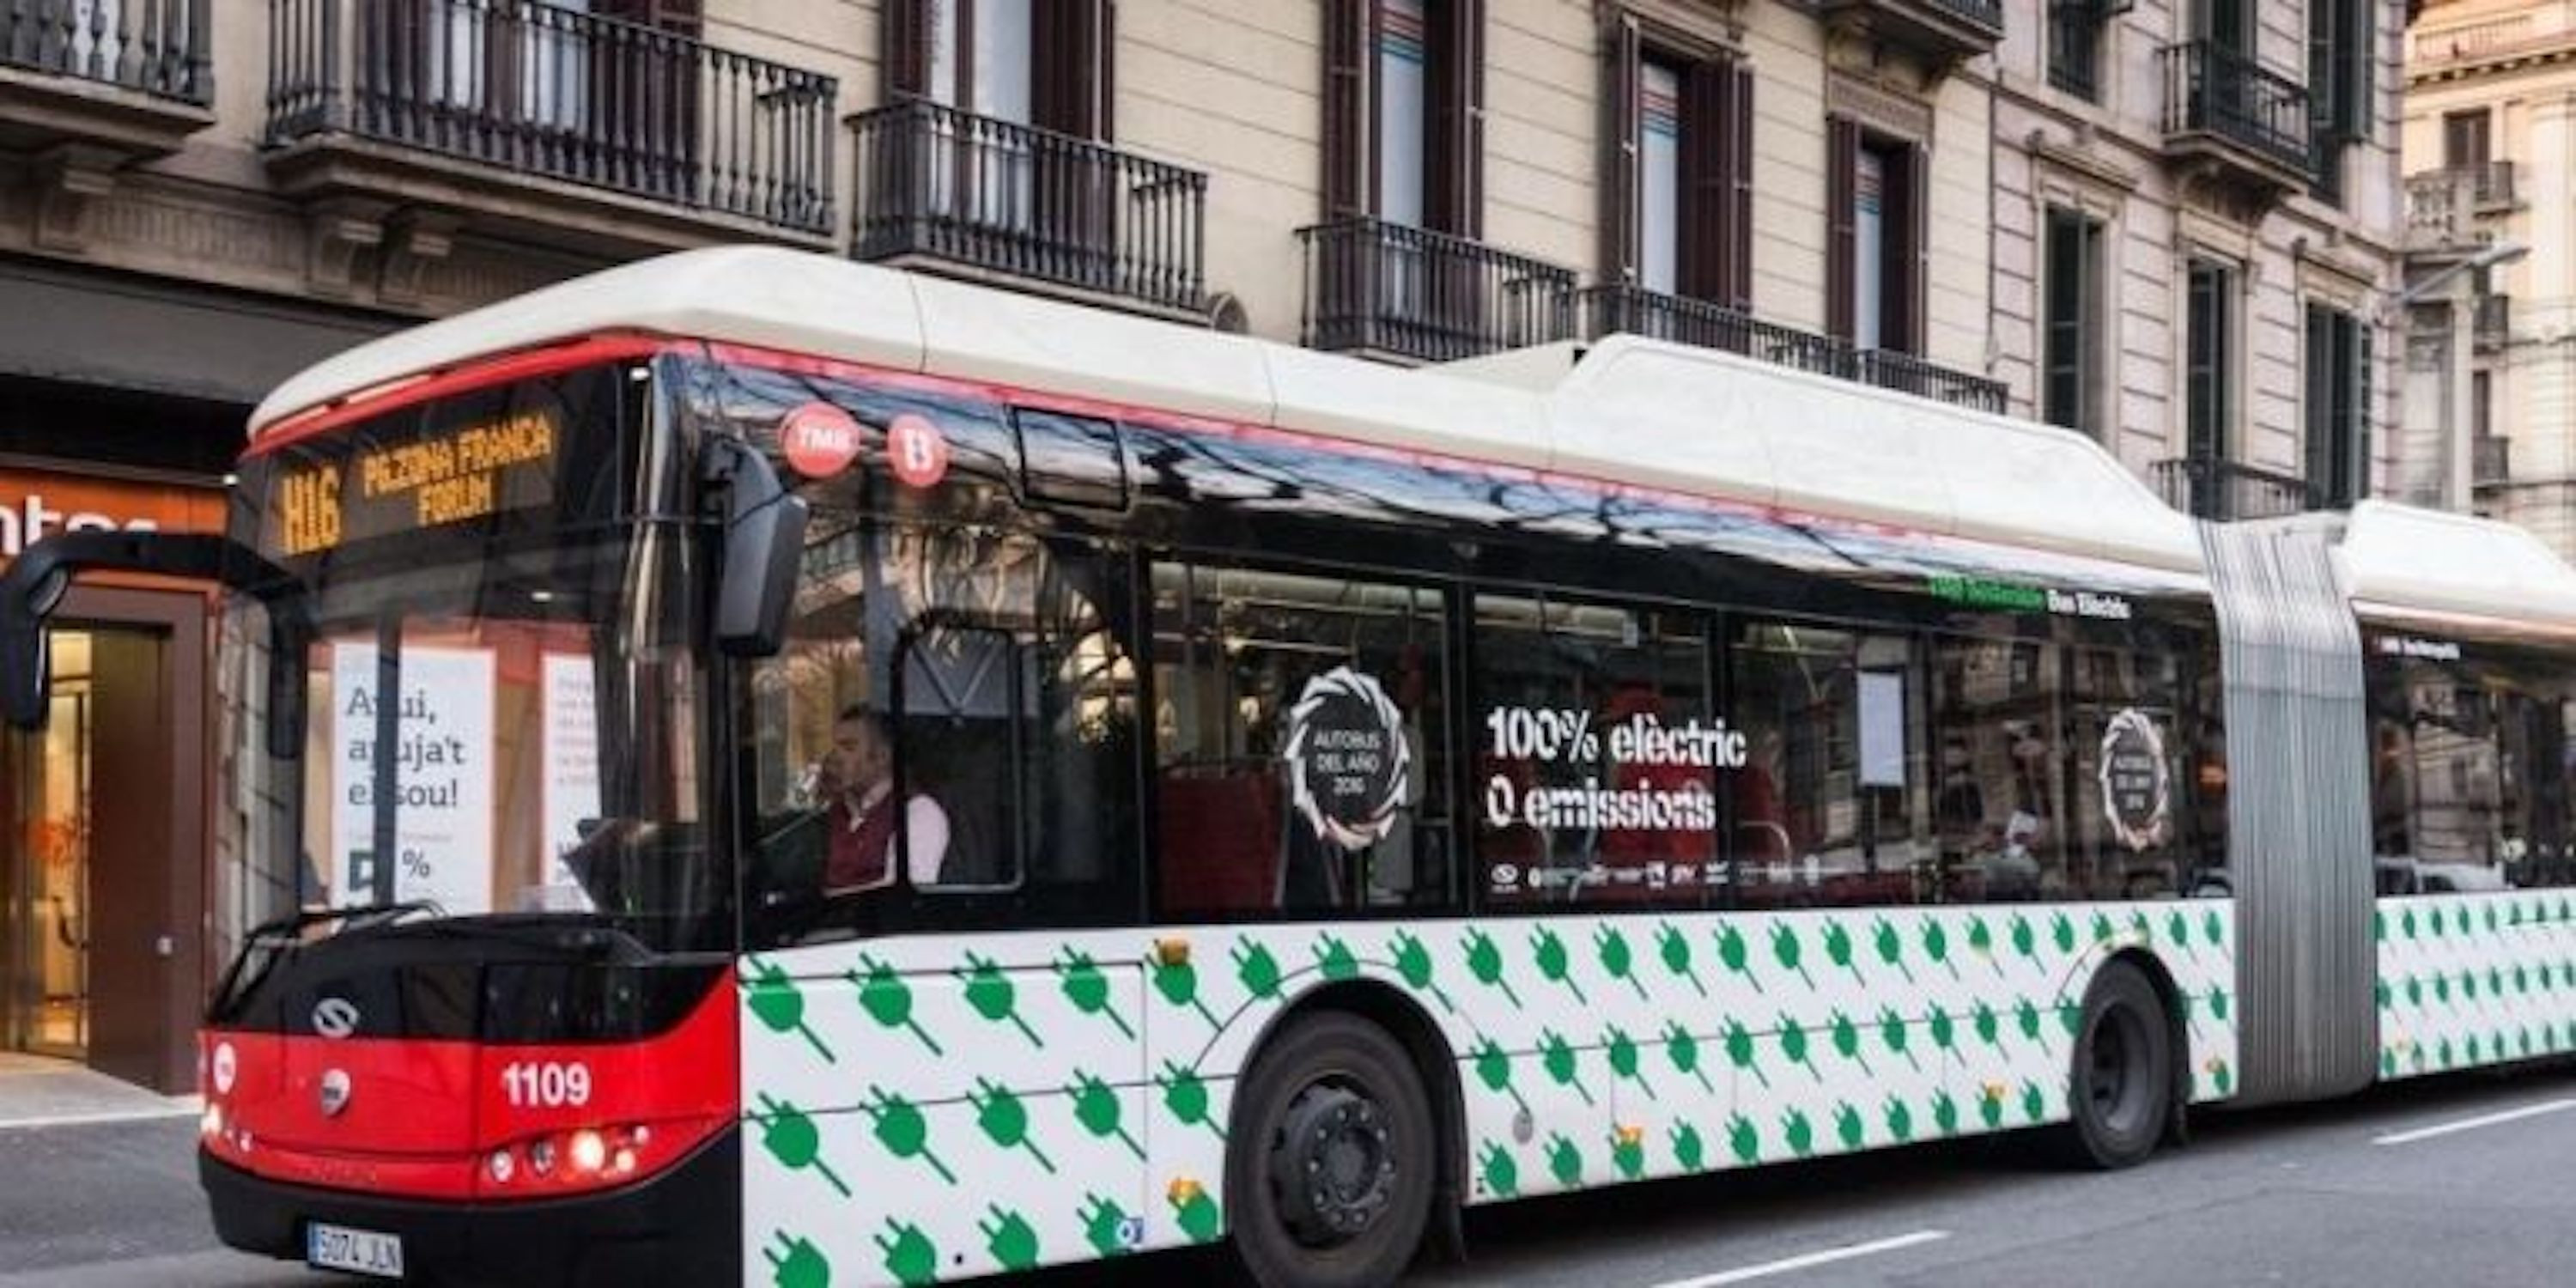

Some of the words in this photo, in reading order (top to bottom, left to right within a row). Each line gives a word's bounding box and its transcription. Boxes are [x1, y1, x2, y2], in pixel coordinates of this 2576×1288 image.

[459, 411, 552, 473] FRANCA
[282, 465, 342, 556] H16
[417, 471, 492, 527] FORUM
[347, 686, 436, 726] Aui,
[349, 733, 465, 773] auja't
[1316, 752, 1345, 772] DEL
[1486, 705, 1601, 763] 100%
[1608, 712, 1748, 767] elèctric
[1486, 773, 1516, 828] 0
[1523, 775, 1716, 831] emissions
[501, 1060, 592, 1108] 1109
